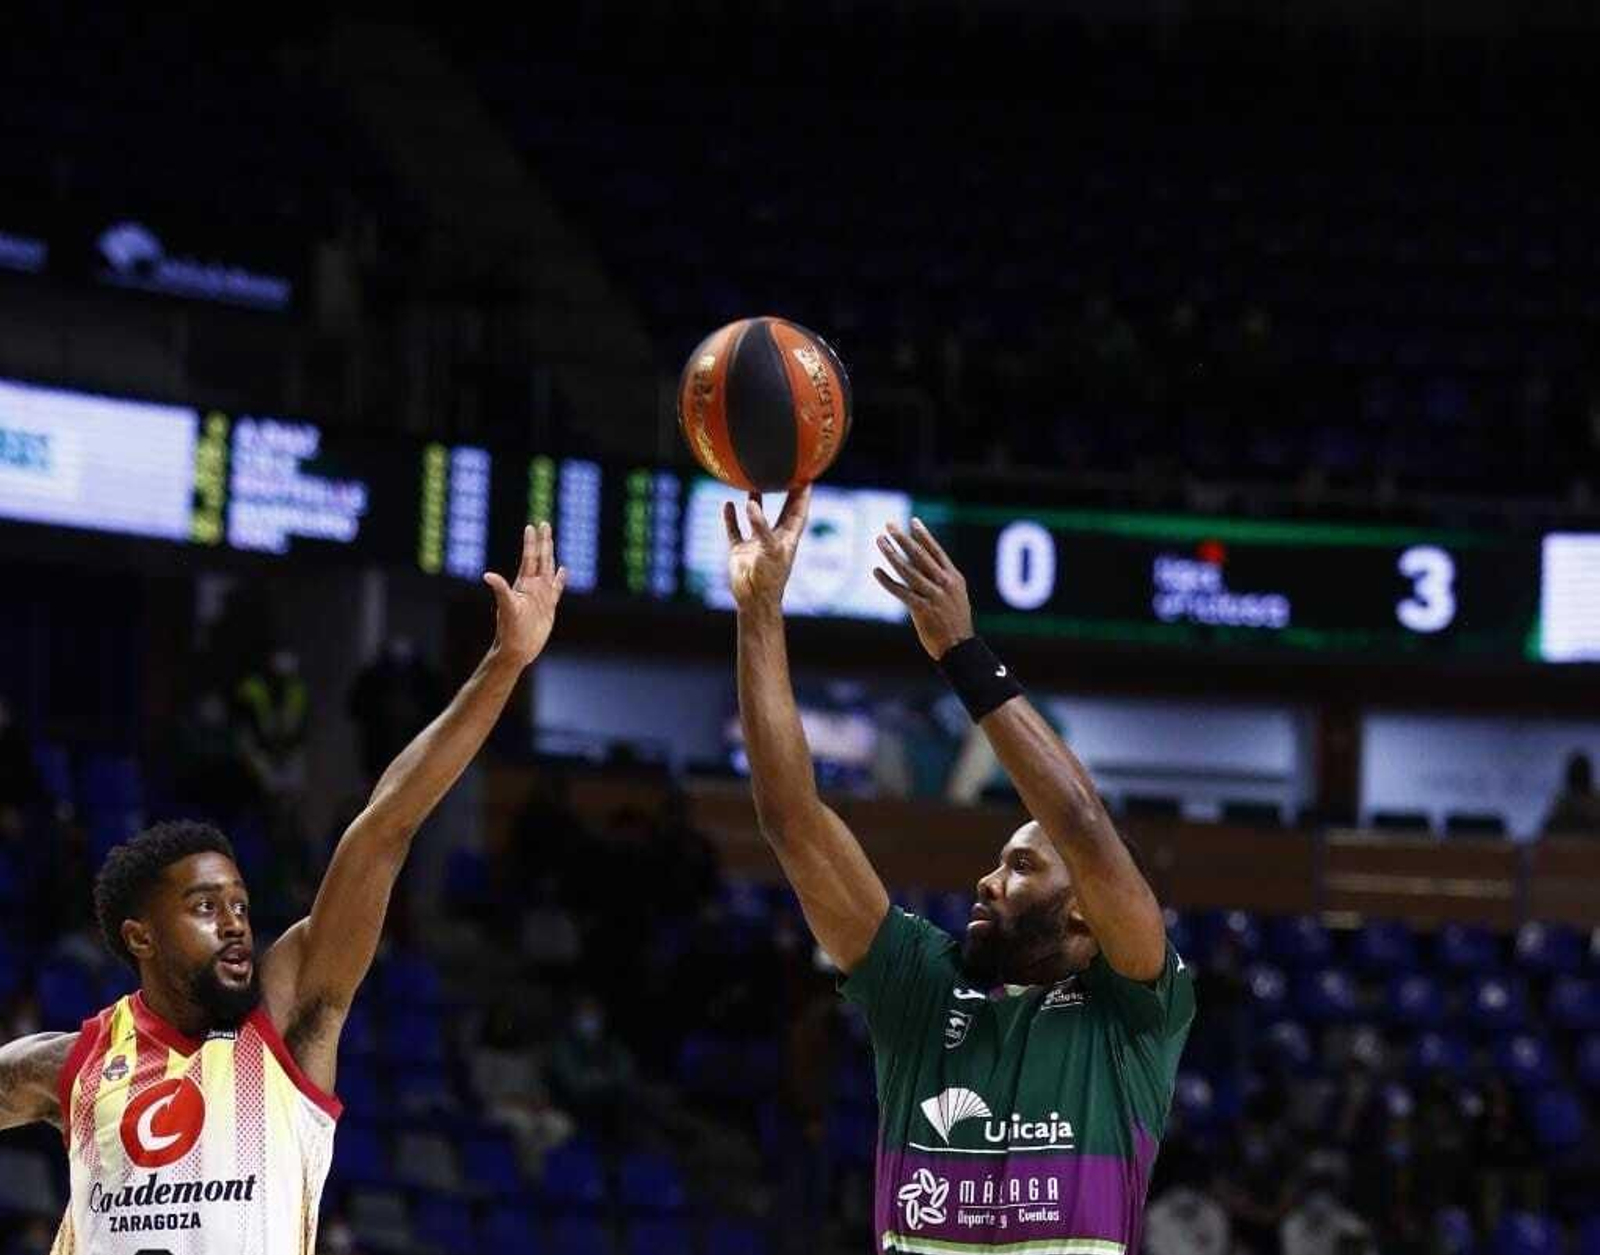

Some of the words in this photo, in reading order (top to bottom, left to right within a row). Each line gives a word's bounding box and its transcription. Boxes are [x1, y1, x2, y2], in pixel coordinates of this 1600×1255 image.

[995, 520, 1056, 609] 0
[1396, 546, 1456, 632] 3
[985, 1112, 1073, 1143] Uicaja
[109, 1212, 202, 1233] ZARAGOZA
